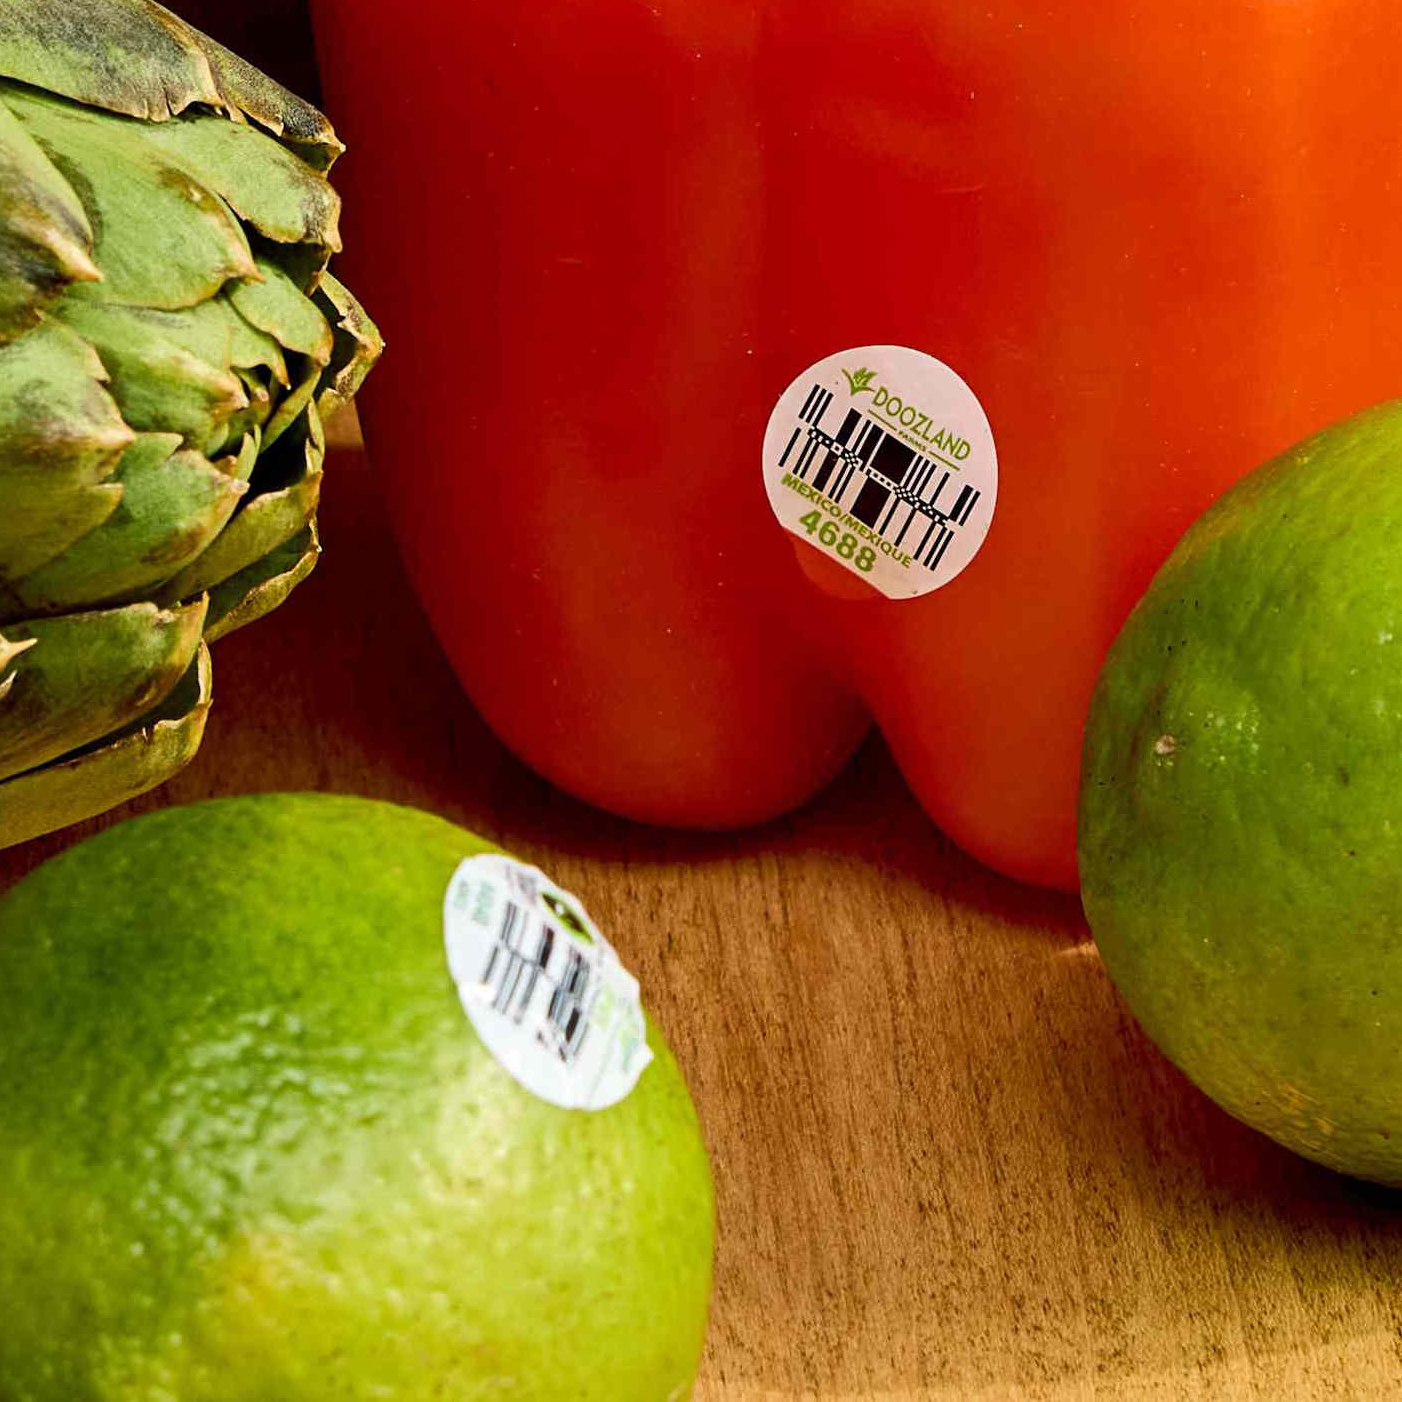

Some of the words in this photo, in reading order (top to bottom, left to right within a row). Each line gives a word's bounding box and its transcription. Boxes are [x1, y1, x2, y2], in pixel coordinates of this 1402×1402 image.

[872, 386, 971, 460] DOOZLAND
[780, 472, 913, 569] MEXICO/MEXIQUE
[799, 509, 877, 573] 4688
